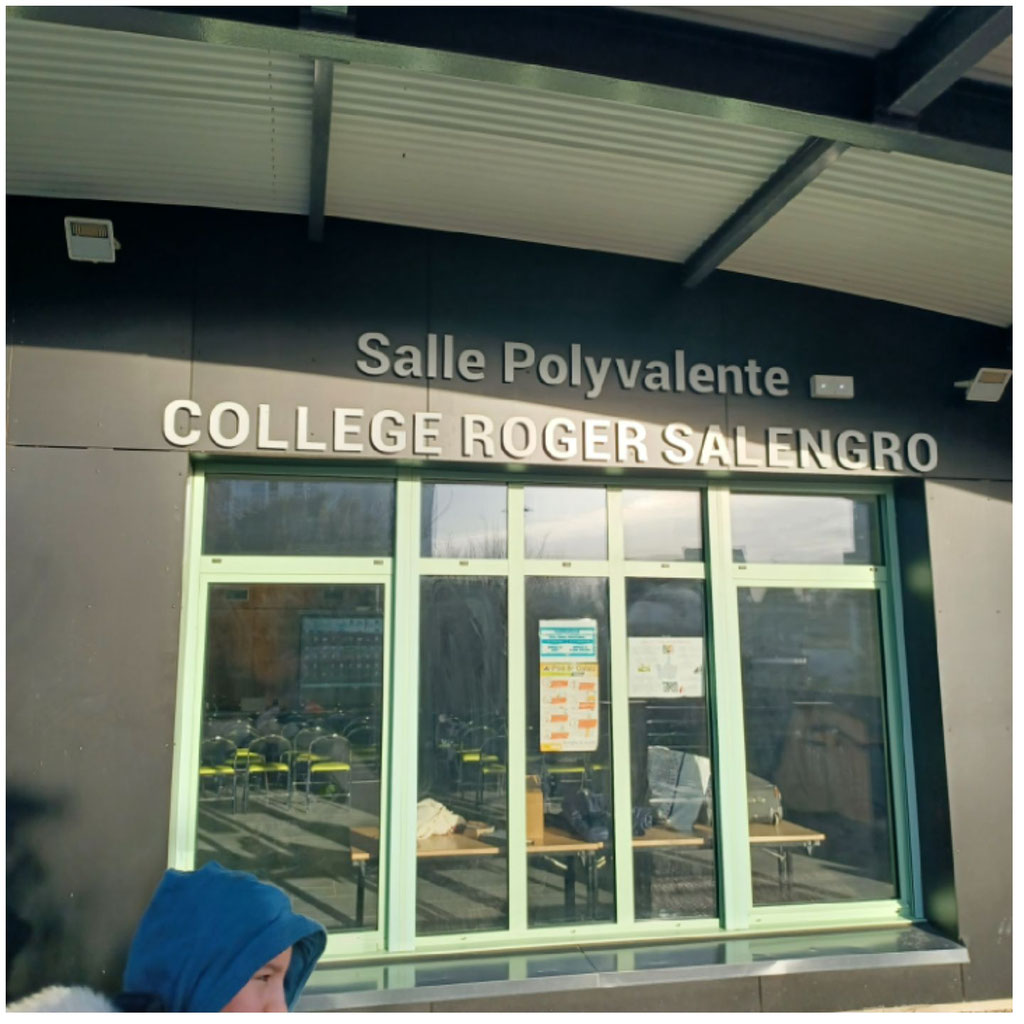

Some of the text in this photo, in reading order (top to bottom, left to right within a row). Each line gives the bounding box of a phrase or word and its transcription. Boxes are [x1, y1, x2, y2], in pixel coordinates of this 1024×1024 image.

[356, 332, 790, 399] Salle Polyvalente
[162, 399, 939, 473] COLLEGE ROGER SALENGRO
